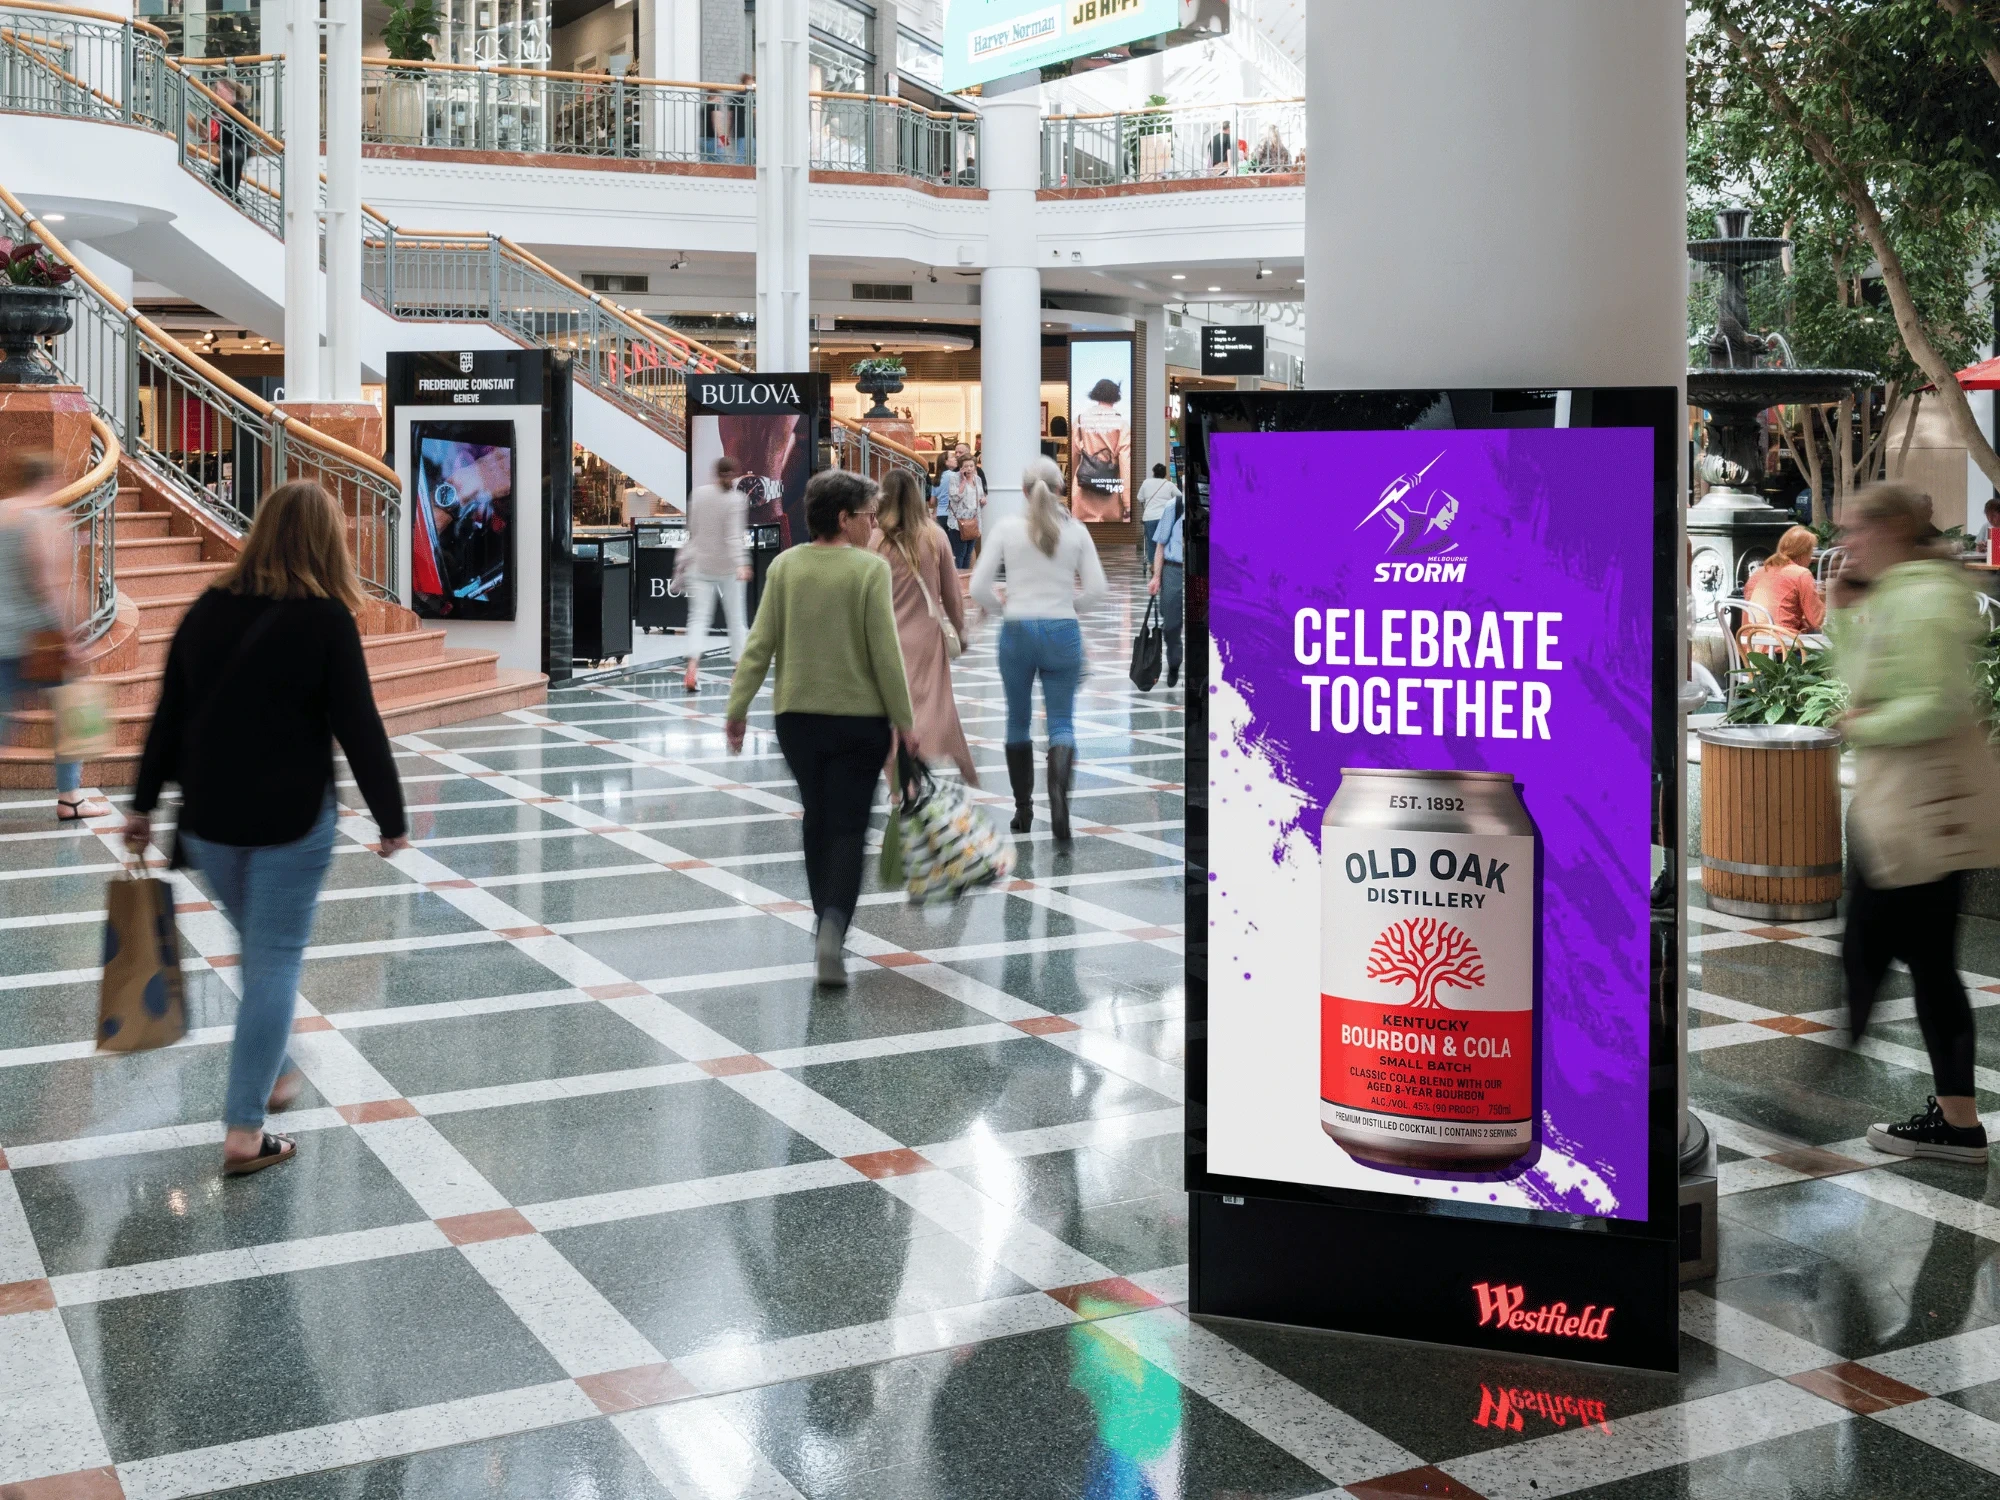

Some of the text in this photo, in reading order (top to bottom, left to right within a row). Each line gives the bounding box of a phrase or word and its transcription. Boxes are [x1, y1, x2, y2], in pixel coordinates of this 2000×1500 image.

[1073, 1, 1096, 25] JB
[974, 30, 1010, 53] Harvey
[1013, 16, 1055, 41] Norman
[419, 378, 514, 391] FREDERIQUE CONSTANT
[701, 383, 801, 405] BULOVA
[453, 394, 480, 403] GENEVE
[1106, 484, 1125, 493] $149
[1373, 562, 1467, 583] STORM
[1294, 607, 1563, 670] CELEBRATE
[1302, 675, 1552, 741] TOGETHER
[1389, 795, 1465, 812] EST. 1892
[1345, 847, 1510, 894] OLD OAK
[1367, 887, 1486, 909] DISTILLERY
[1382, 1014, 1470, 1032] KENTUCKY
[1341, 1023, 1511, 1058] BOURBON & COLA
[1379, 1055, 1472, 1073] SMALL BATCH
[1350, 1066, 1503, 1090] CLASSIC COLA BLEND WITH OUR
[1367, 1081, 1485, 1101] AGED 8-YEAR BOURBON
[1413, 1101, 1430, 1112] 45%
[1432, 1103, 1446, 1114] (90
[1448, 1104, 1480, 1116] PROOF)
[1488, 1103, 1512, 1116] 750ml
[1335, 1111, 1518, 1138] PREMIUM DISTILLED COCKTAIL CONTAINS 2 SERVINGS
[1472, 1281, 1615, 1340] Westfield
